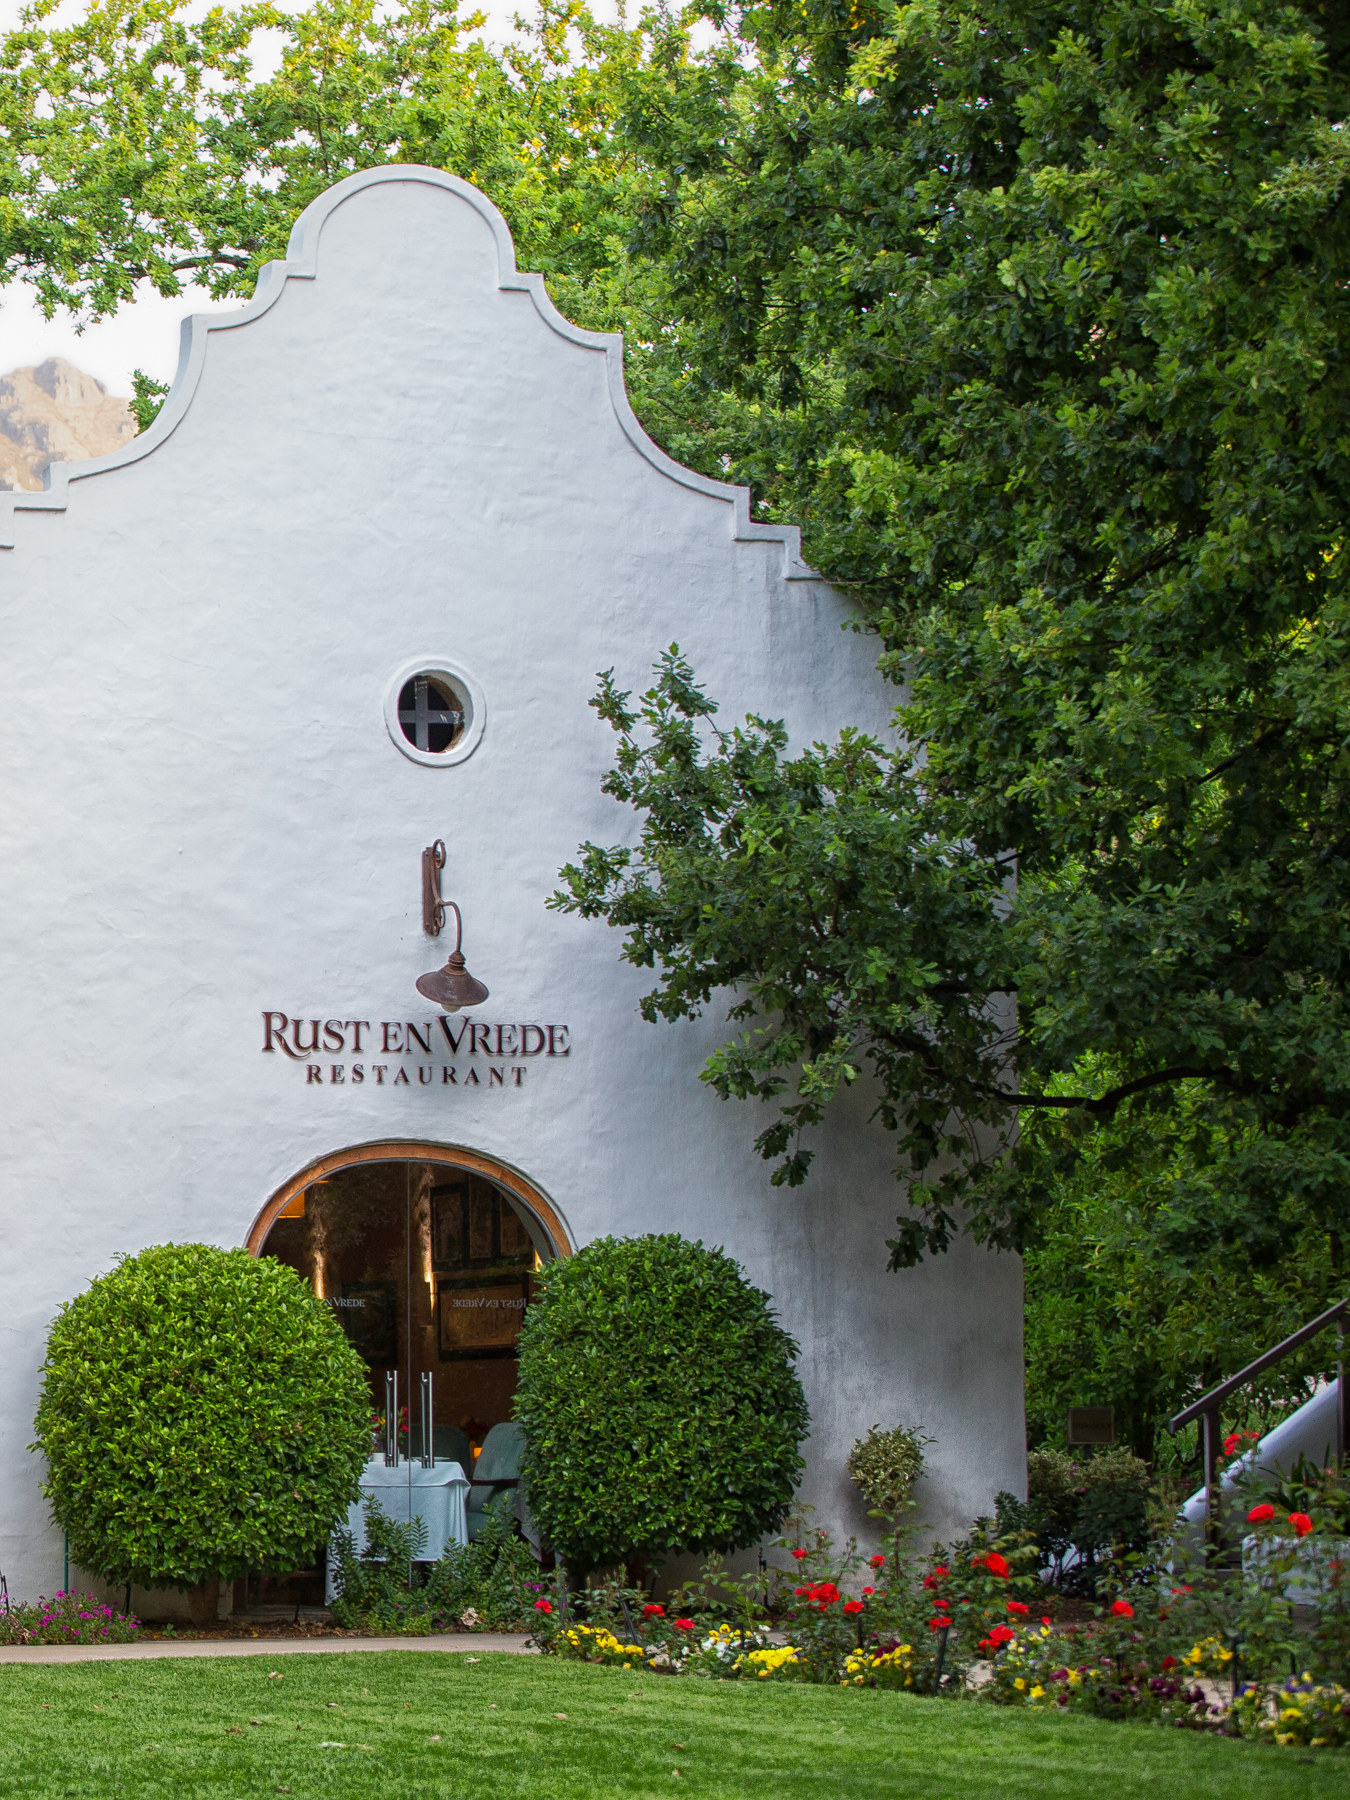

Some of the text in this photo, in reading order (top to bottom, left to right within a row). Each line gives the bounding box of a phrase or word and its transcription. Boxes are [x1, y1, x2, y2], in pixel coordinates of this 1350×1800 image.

[261, 1011, 571, 1059] RUST EN VREDE
[305, 1064, 527, 1086] RESTAURANT
[332, 1296, 366, 1308] VREDE
